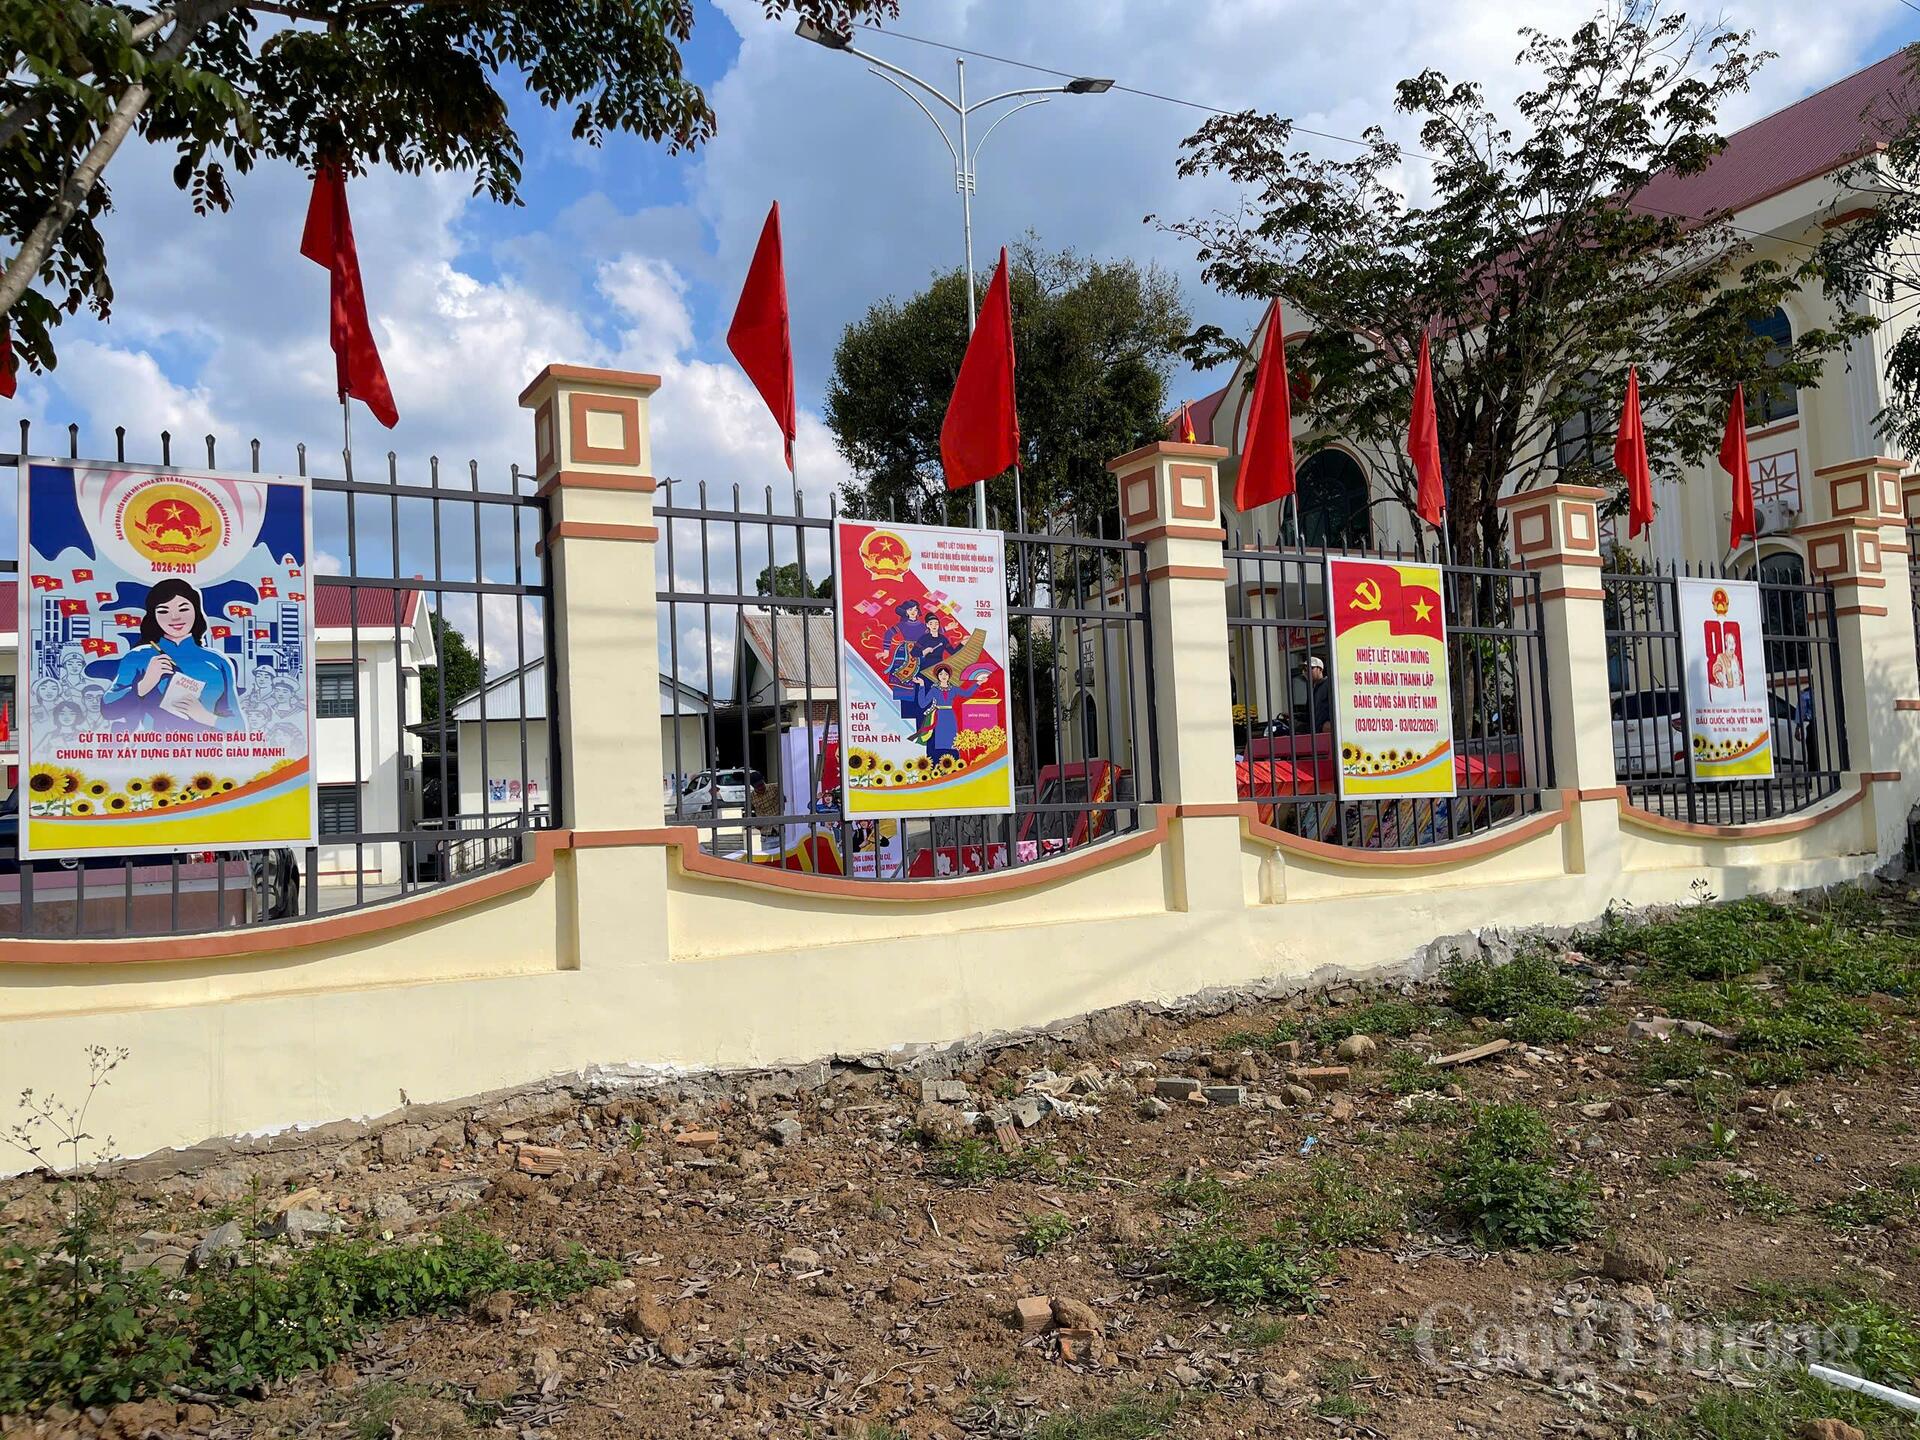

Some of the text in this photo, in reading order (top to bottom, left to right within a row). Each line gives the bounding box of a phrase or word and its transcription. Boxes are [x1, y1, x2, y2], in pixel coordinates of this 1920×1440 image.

[151, 562, 197, 574] 2026-2031
[976, 600, 990, 608] 15/3
[1356, 646, 1430, 665] NHIỆT LIỆT CHÀO MỪNG
[1354, 670, 1434, 689] 96 NĂM NGÀY THÀNH LẬP
[1354, 691, 1438, 712] ĐẢNG CỘNG SẢN VIỆT NAM
[1355, 718, 1394, 732] (03/02/1930
[79, 730, 266, 743] CỬ TRI CẢ NƯỚC ĐỒNG LÒNG BẦU CỬ,
[56, 746, 285, 760] CHUNG TAY XÂY DỰNG ĐẤT NƯỚC GIÀU MẠNH!
